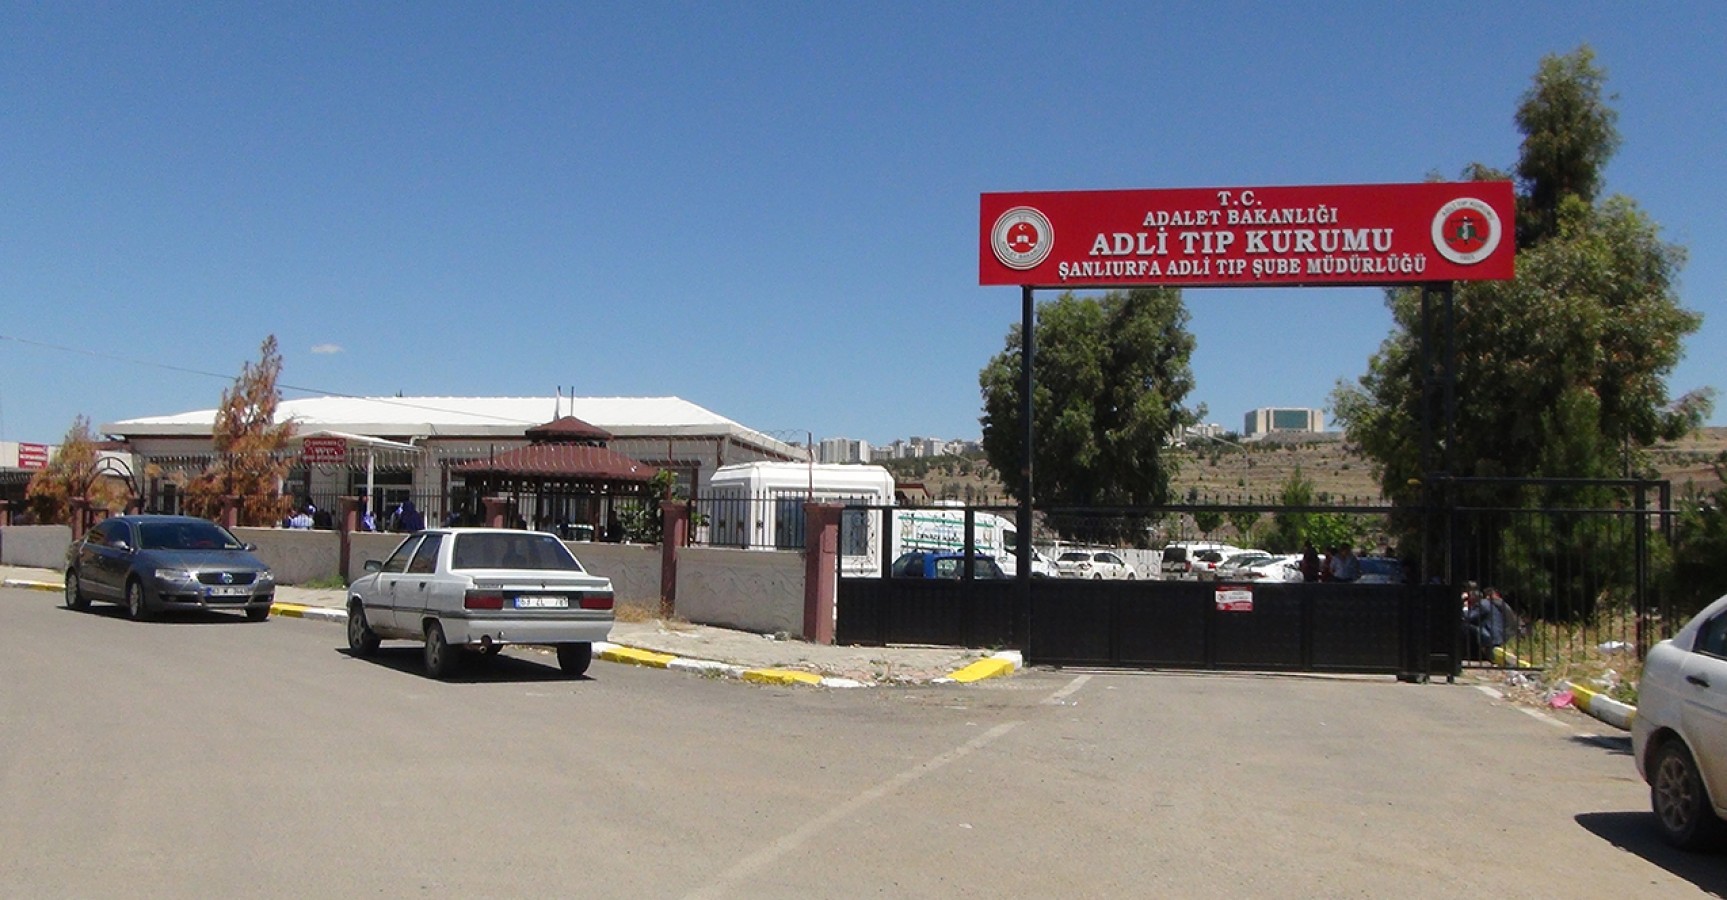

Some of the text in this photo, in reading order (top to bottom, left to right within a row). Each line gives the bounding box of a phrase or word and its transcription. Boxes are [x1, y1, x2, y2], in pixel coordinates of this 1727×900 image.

[1218, 190, 1263, 206] T.C.
[1143, 204, 1338, 226] ADALET BAKANLIĞI
[1089, 226, 1394, 256] ADLİ TIP KURUMU
[1058, 252, 1427, 280] ŞANLIURFA ADLİ TIP ŞUBE MÜDÜRLÜĞÜ
